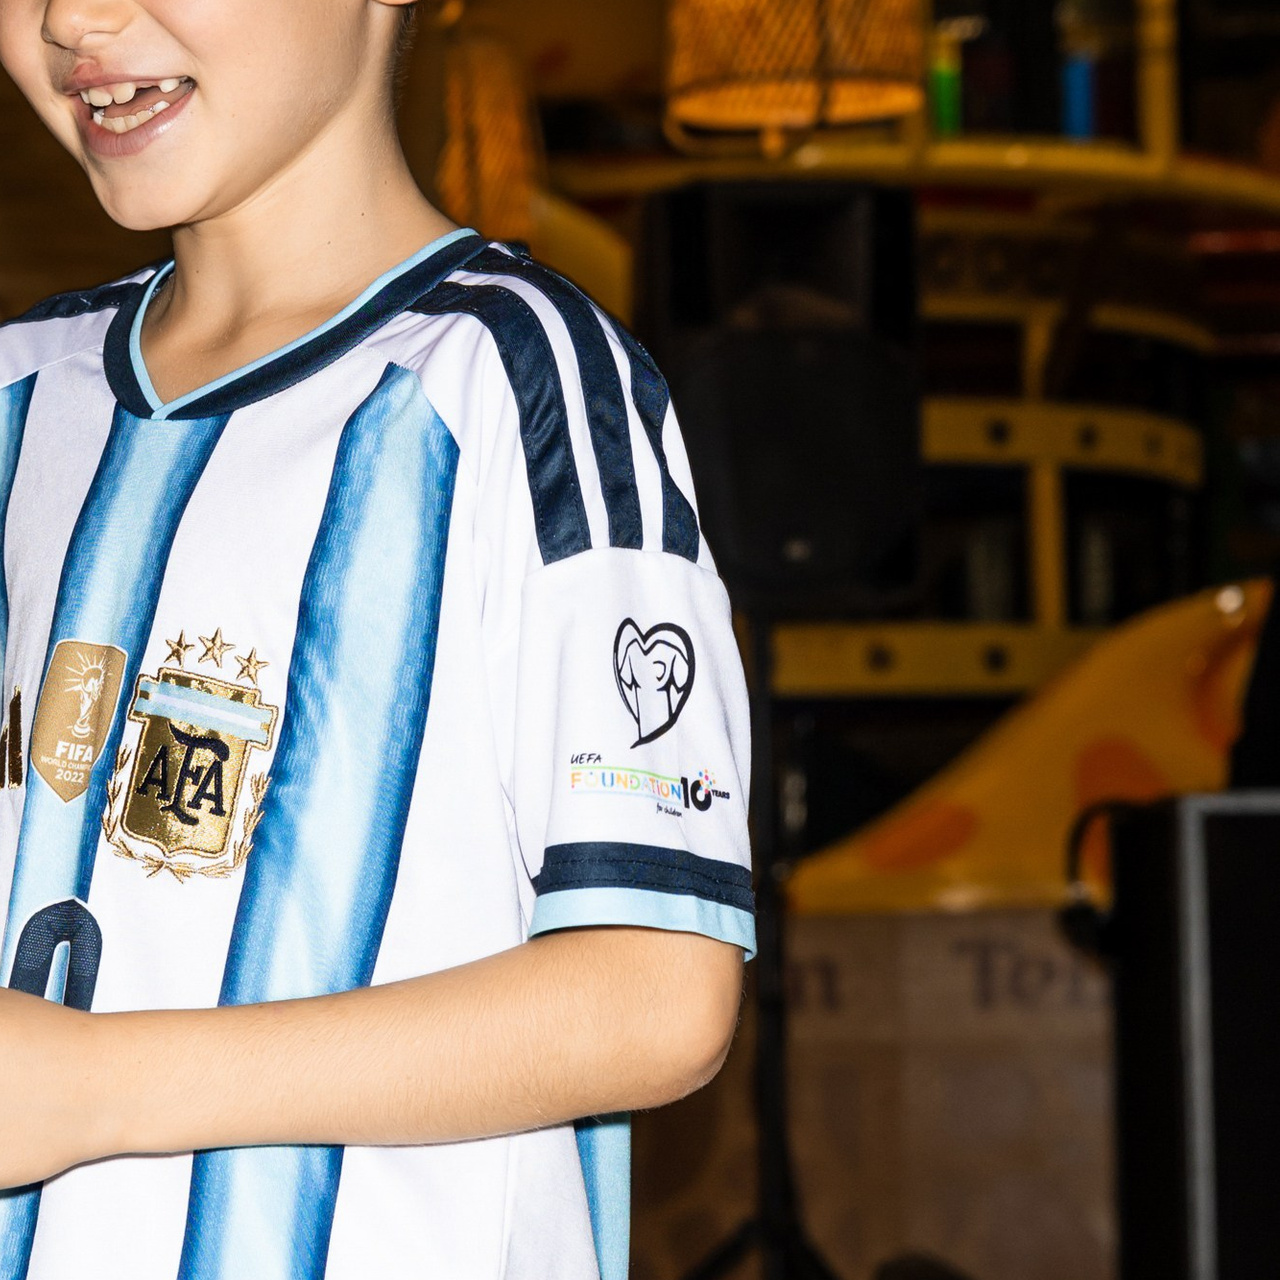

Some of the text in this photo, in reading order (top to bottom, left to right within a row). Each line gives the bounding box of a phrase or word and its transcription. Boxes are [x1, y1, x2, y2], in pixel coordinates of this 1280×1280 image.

[55, 740, 94, 763] FIFA
[570, 753, 602, 764] UEFA
[40, 755, 67, 769] WORLD
[55, 768, 85, 784] 2022
[135, 721, 230, 826] AFA
[571, 772, 682, 800] FOUNDATION
[711, 789, 731, 800] YEARS
